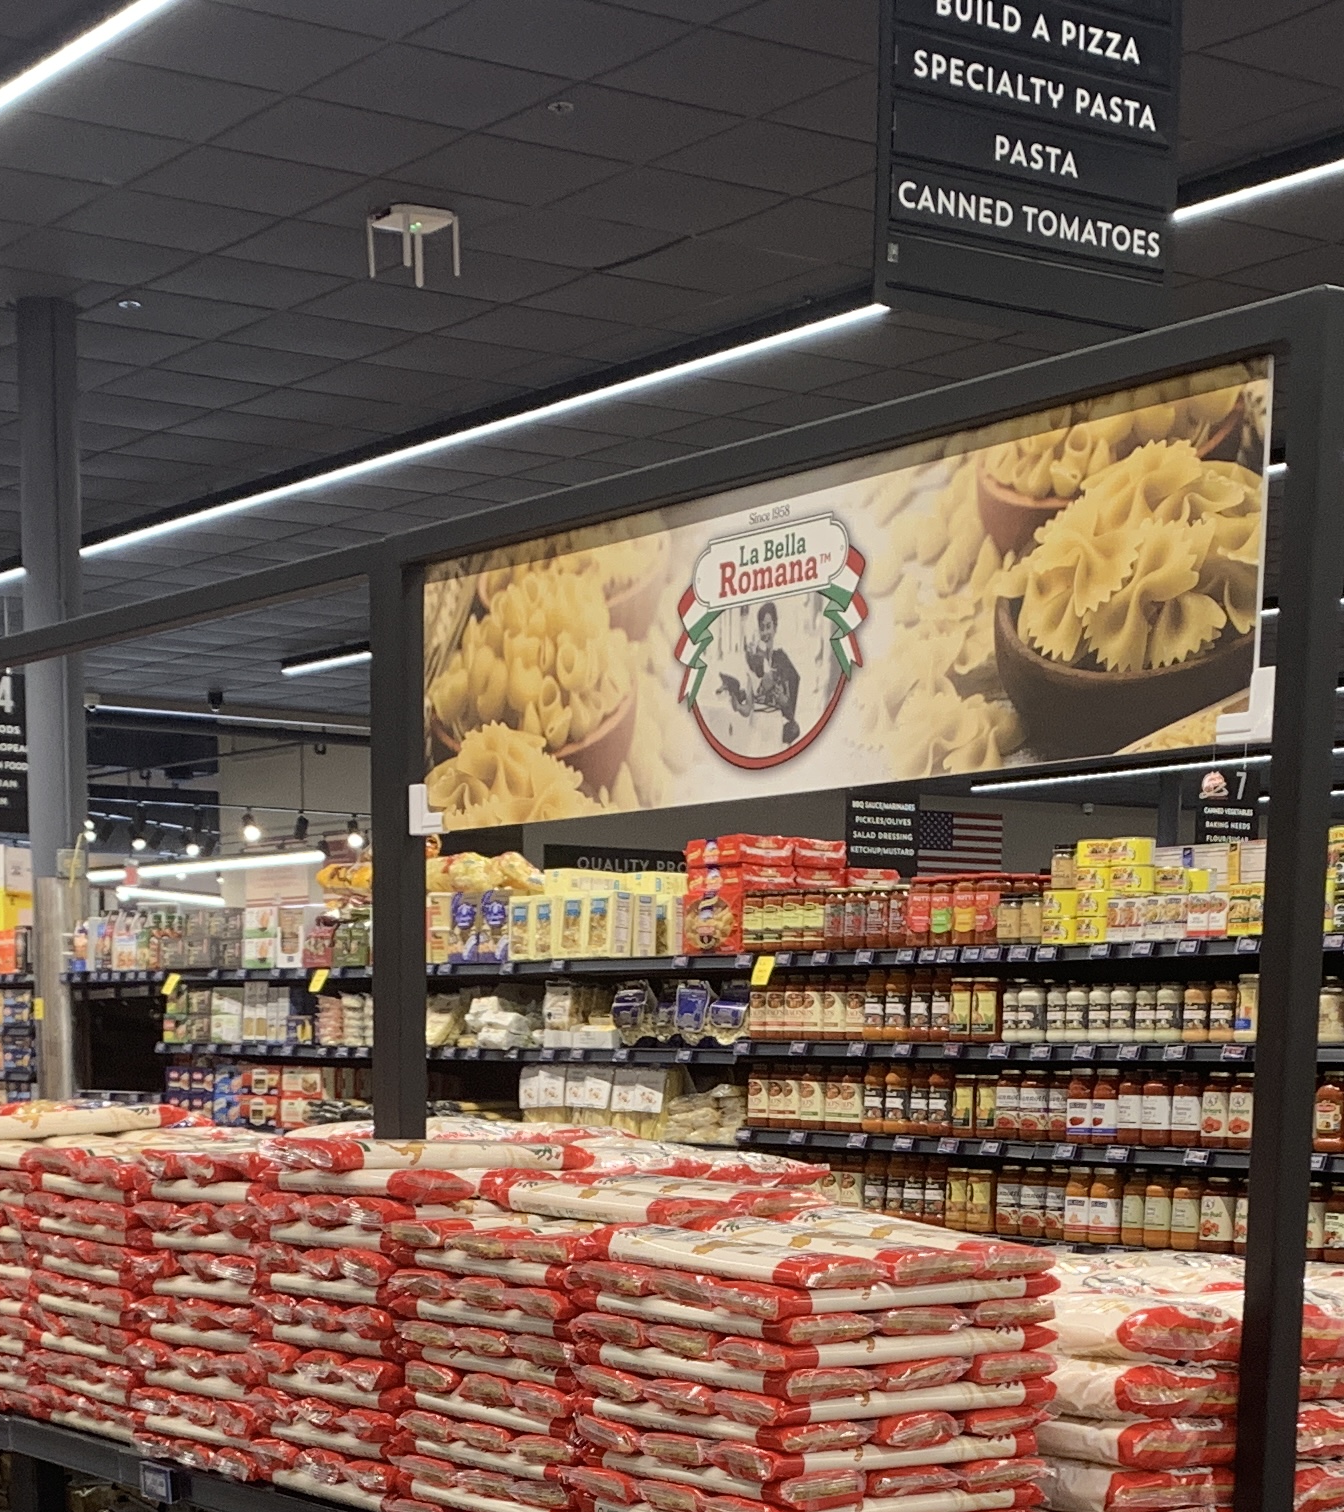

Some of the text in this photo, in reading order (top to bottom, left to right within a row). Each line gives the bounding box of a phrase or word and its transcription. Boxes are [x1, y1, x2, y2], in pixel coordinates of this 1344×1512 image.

[935, 0, 1140, 65] BUILD A PIZZA
[913, 49, 1156, 132] SPECIALTY PASTA
[994, 134, 1079, 179] PASTA
[898, 181, 1160, 258] CANNED TOMATOES
[749, 505, 790, 525] Since 1958
[740, 533, 806, 567] La Bella
[719, 555, 818, 599] Romana
[5, 761, 28, 770] FOOD
[1236, 772, 1246, 800] 7
[855, 816, 911, 826] PICKLES/OLIVES
[1230, 822, 1250, 830] NEEDS
[853, 831, 913, 841] SALAD DRESSING
[851, 846, 914, 856] KETCHUP/MUSTARD
[577, 856, 687, 873] QUALITY PRO
